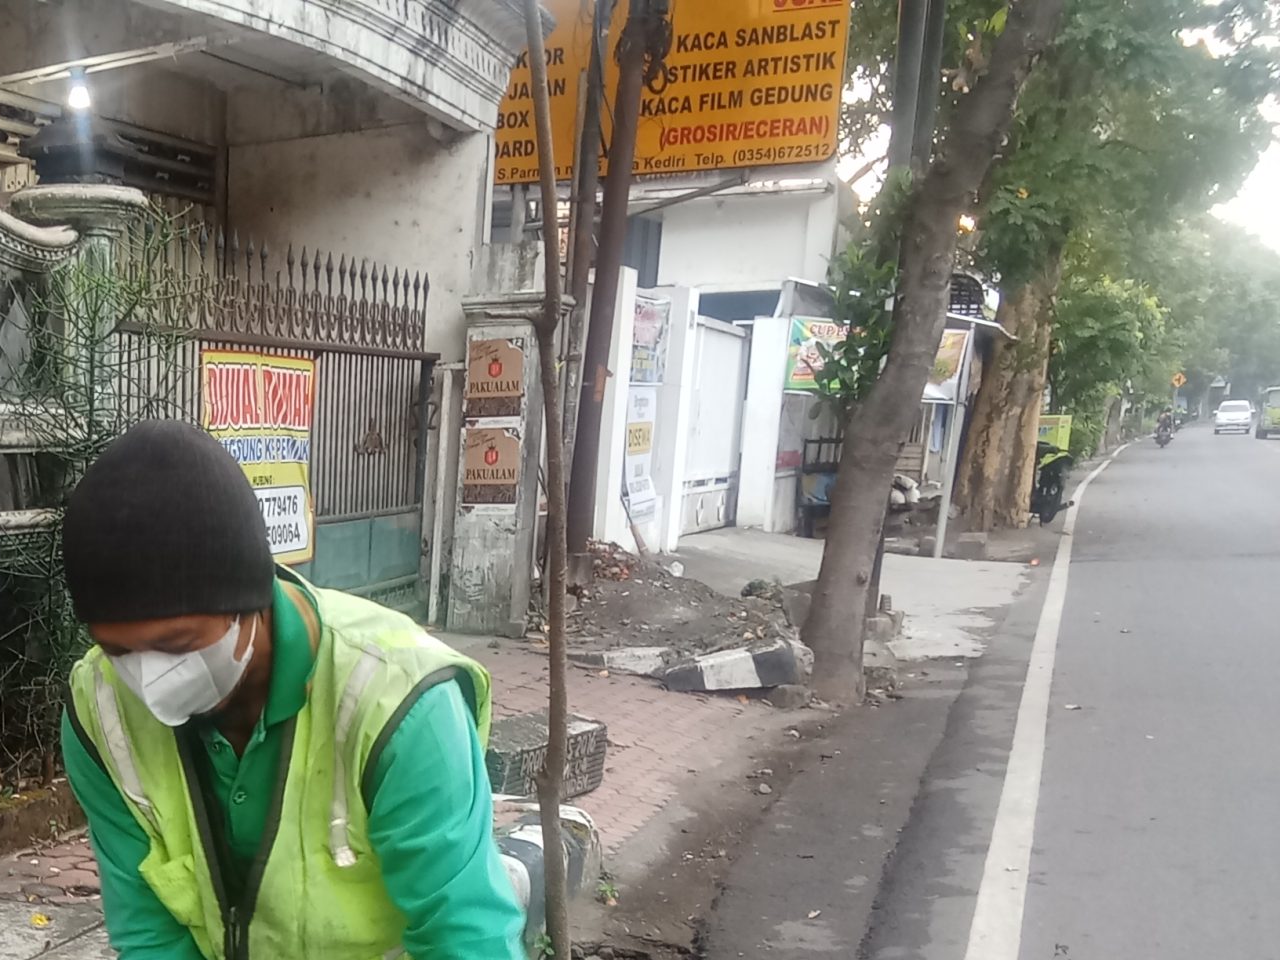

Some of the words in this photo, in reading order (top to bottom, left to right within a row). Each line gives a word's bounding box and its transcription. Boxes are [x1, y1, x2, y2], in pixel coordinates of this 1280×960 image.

[677, 31, 728, 53] KACA
[735, 20, 840, 46] SANBLAST
[667, 60, 736, 84] STIKER
[743, 51, 836, 77] ARTISTIK
[640, 96, 692, 117] KACA
[699, 90, 743, 112] FILM
[750, 83, 833, 106] GEDUNG
[659, 115, 830, 151] (GROSIR/ECERAN)
[644, 156, 685, 170] Kediri
[695, 152, 726, 167] Telp.
[733, 143, 830, 164] (0354)672512
[206, 364, 261, 429] DIJUAL
[470, 380, 520, 393] PAKUALAM
[465, 468, 516, 481] PAKUALAM
